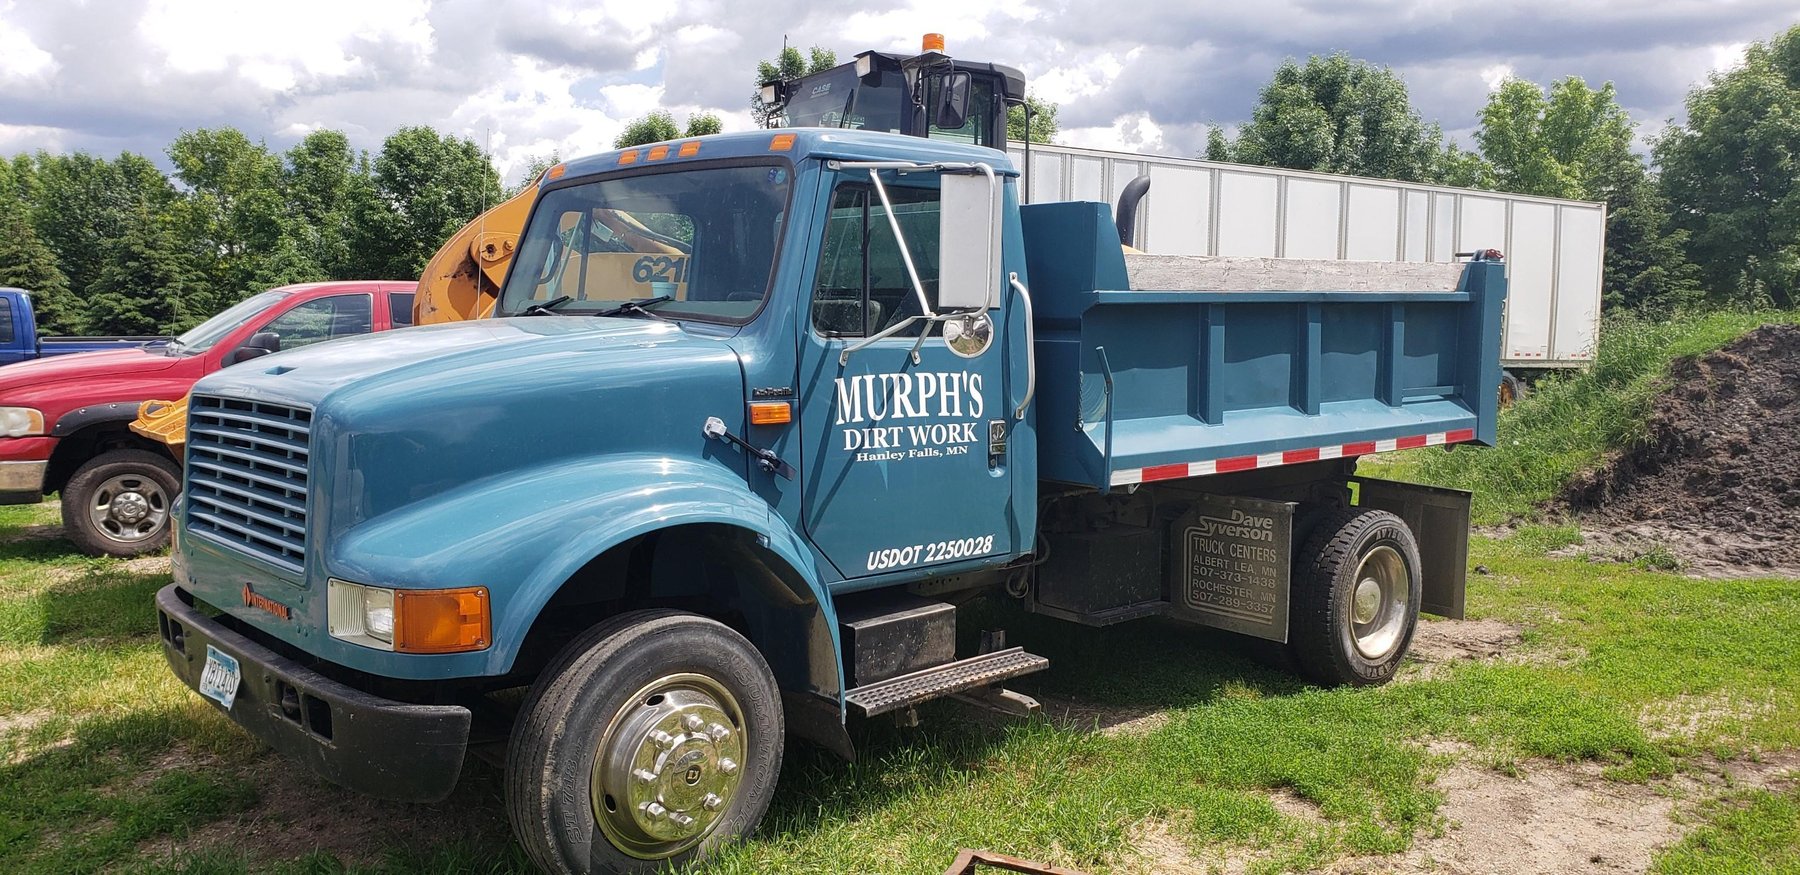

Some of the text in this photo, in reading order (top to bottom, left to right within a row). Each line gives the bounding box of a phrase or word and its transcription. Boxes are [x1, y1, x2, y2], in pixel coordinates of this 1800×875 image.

[812, 83, 831, 95] CASE
[834, 370, 984, 426] MURPH'S
[843, 422, 979, 451] DIRT WORK
[856, 445, 969, 462] Hanley Falls, MN
[1200, 519, 1273, 542] Syverson
[1231, 509, 1273, 530] Dave
[867, 534, 993, 571] USDOT 2250028
[1193, 537, 1277, 563] TRUCK CENTERS
[1193, 554, 1277, 578] ALBERT LEA, MN
[1193, 565, 1276, 589] 507-373-1438
[251, 593, 289, 620] INTERNATIONAL
[1192, 590, 1276, 614] 507-289-3357
[1261, 591, 1276, 603] MN
